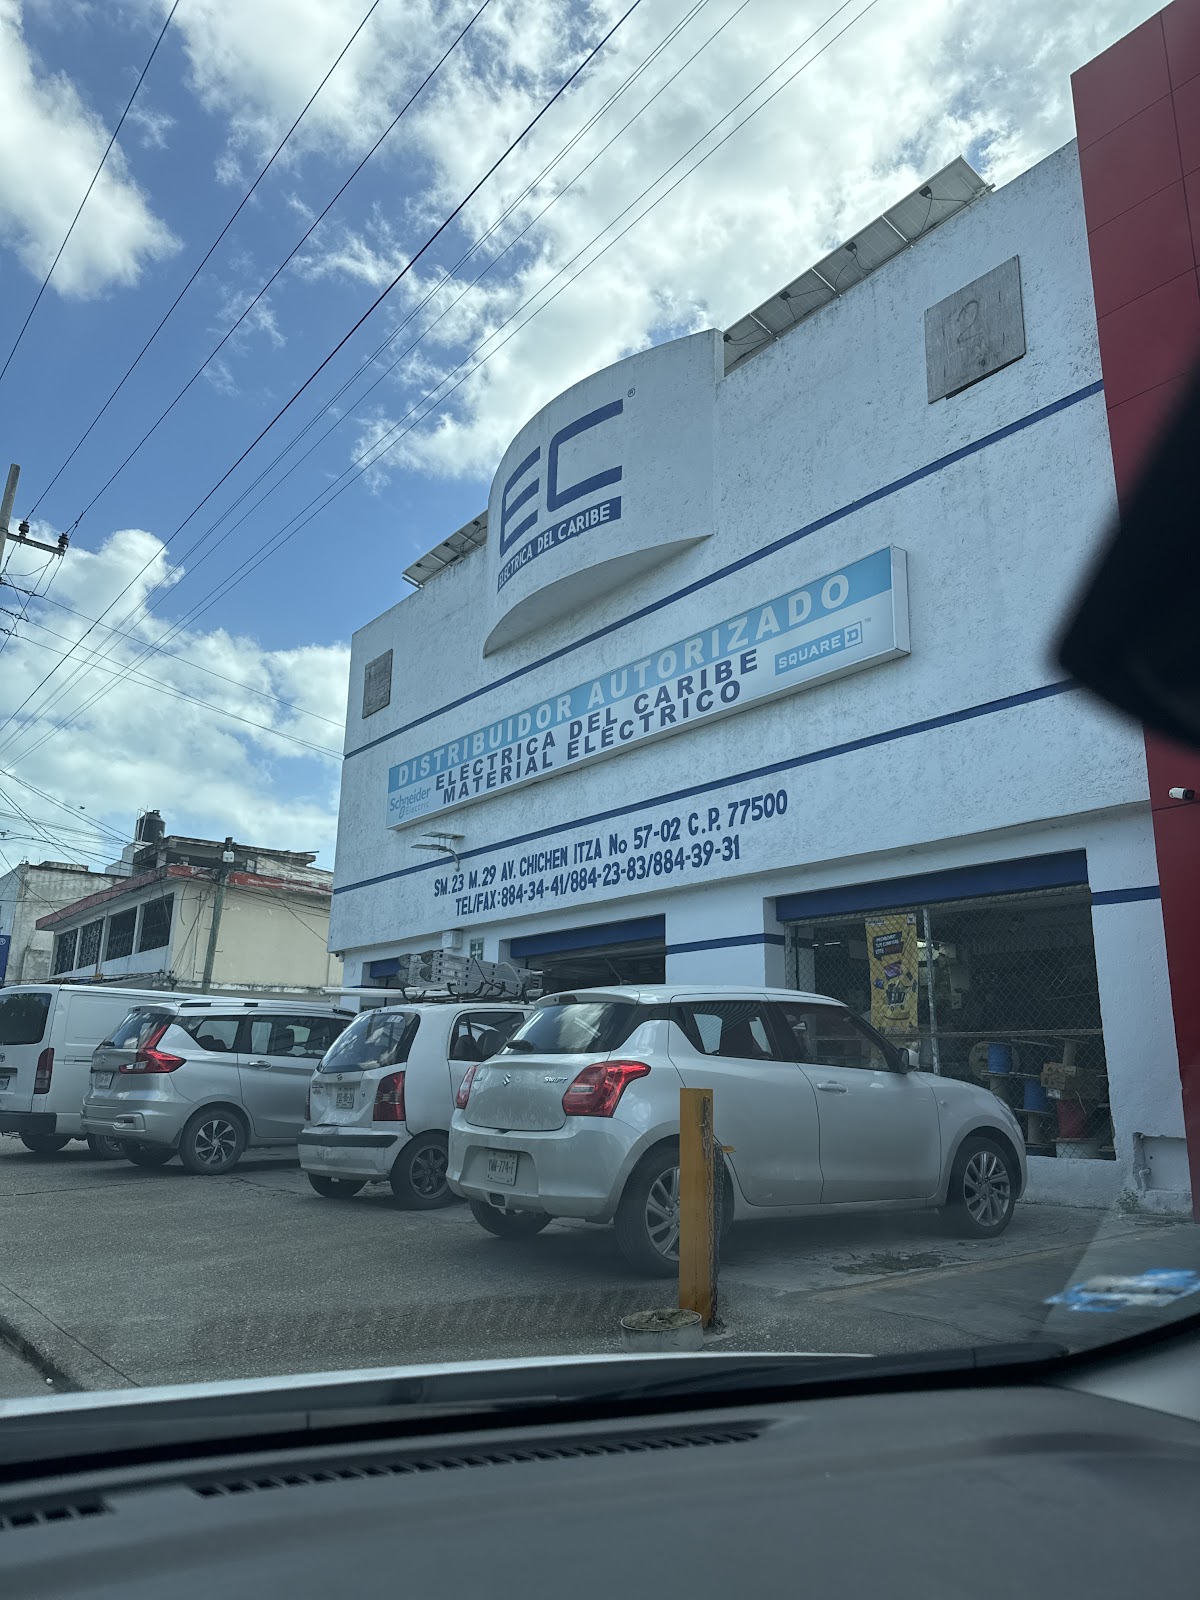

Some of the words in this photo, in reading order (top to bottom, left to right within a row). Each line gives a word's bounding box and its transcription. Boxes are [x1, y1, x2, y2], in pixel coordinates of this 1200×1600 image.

[500, 398, 623, 558] EC
[499, 543, 533, 588] ELECTRICA
[537, 530, 555, 554] DEL
[557, 502, 610, 541] CARIBE
[398, 694, 572, 787] DISTRIBUIDOR
[588, 574, 849, 709] AUTORIZADO
[569, 707, 618, 740] DEL
[633, 649, 758, 715] CARIBE
[778, 634, 841, 669] SQUARE
[389, 787, 431, 811] Schneider
[405, 801, 430, 815] Electric
[442, 750, 553, 804] MATERIAL
[434, 873, 464, 898] SM.23
[468, 865, 497, 889] M.29
[500, 860, 516, 882] AV.
[519, 845, 568, 877] CHICHEN
[573, 837, 602, 865] ITZA
[633, 816, 681, 850] 57-02
[727, 789, 788, 828] 77500
